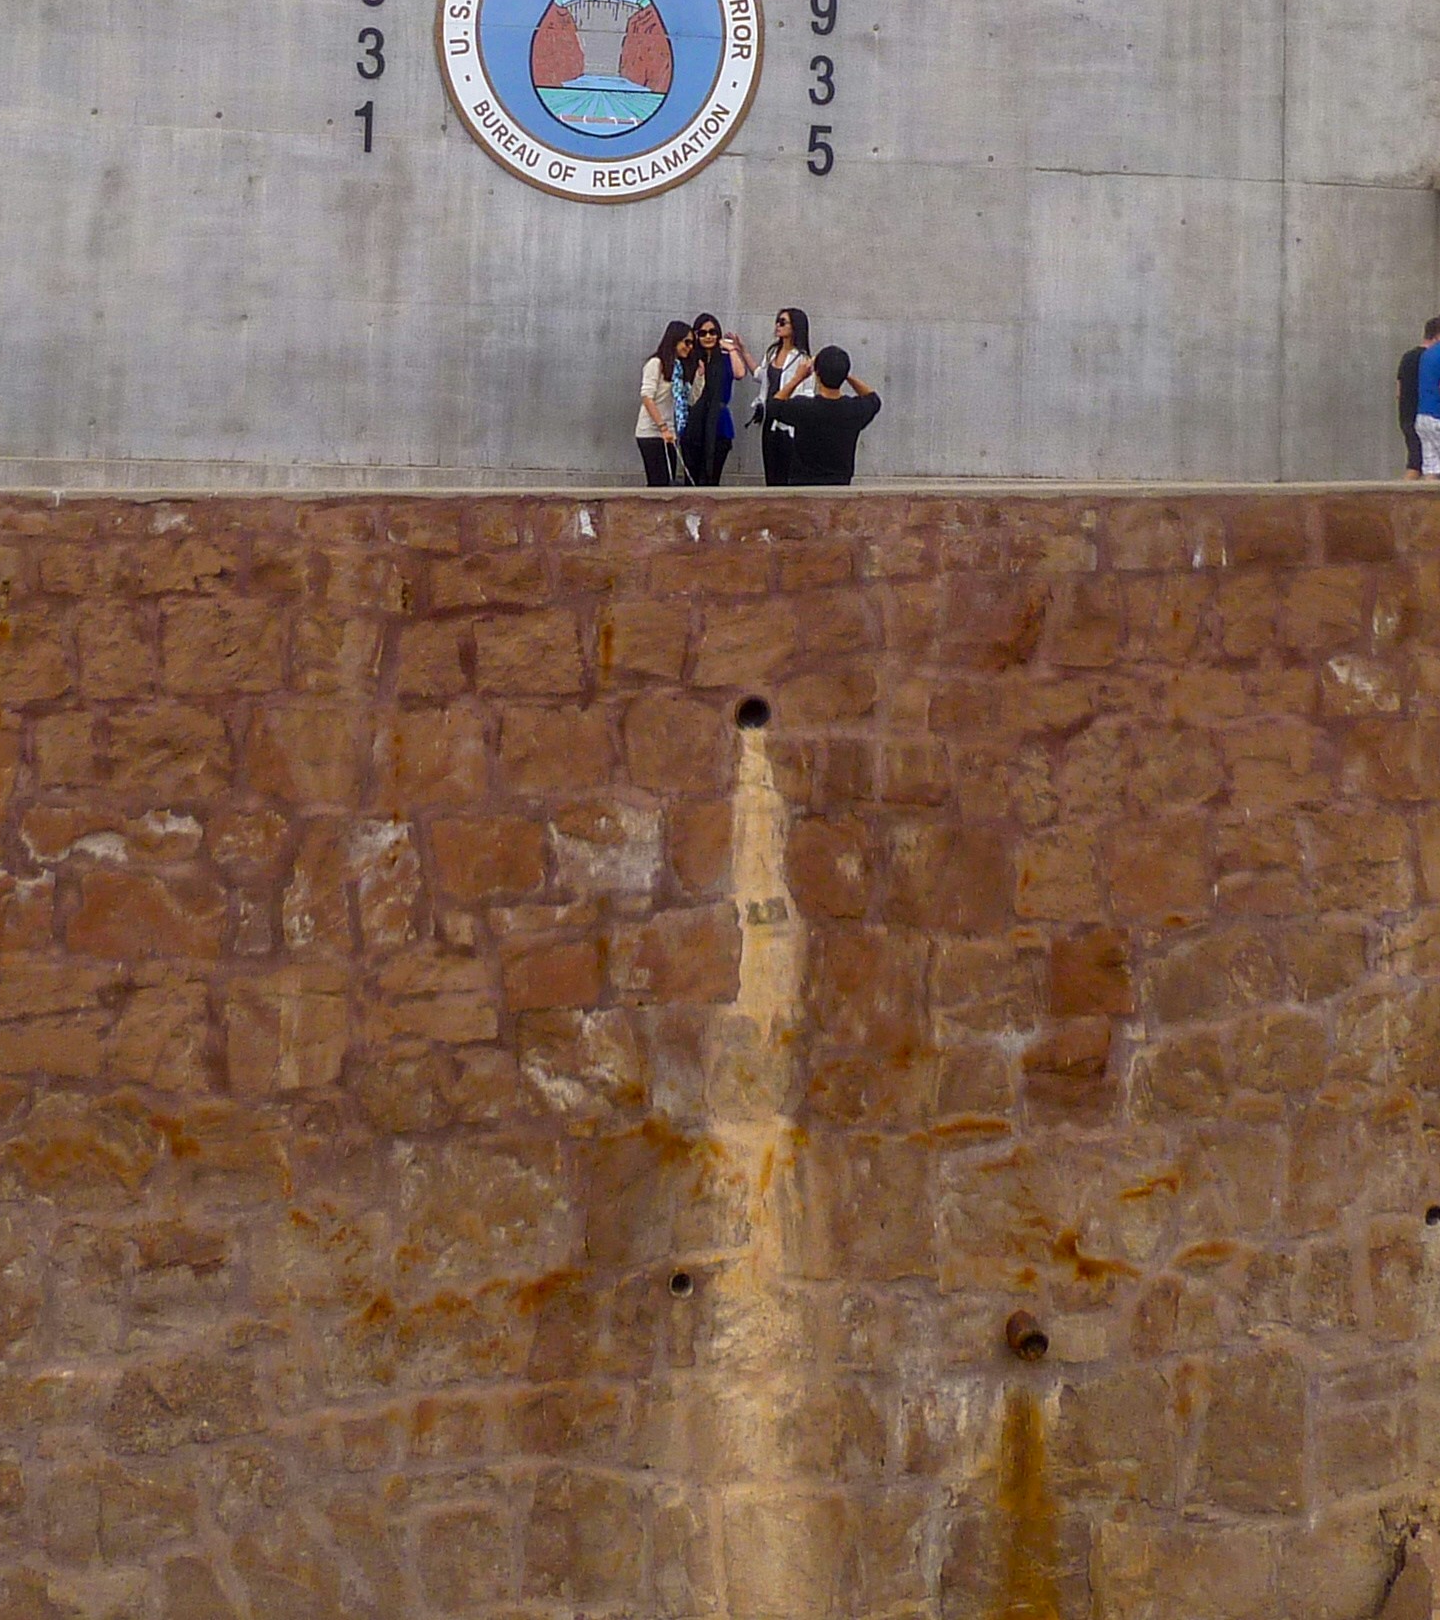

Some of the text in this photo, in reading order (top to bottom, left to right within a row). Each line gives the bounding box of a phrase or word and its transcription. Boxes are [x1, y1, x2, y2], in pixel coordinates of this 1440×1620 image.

[472, 98, 732, 188] BUREAU OF RECLAMATION
